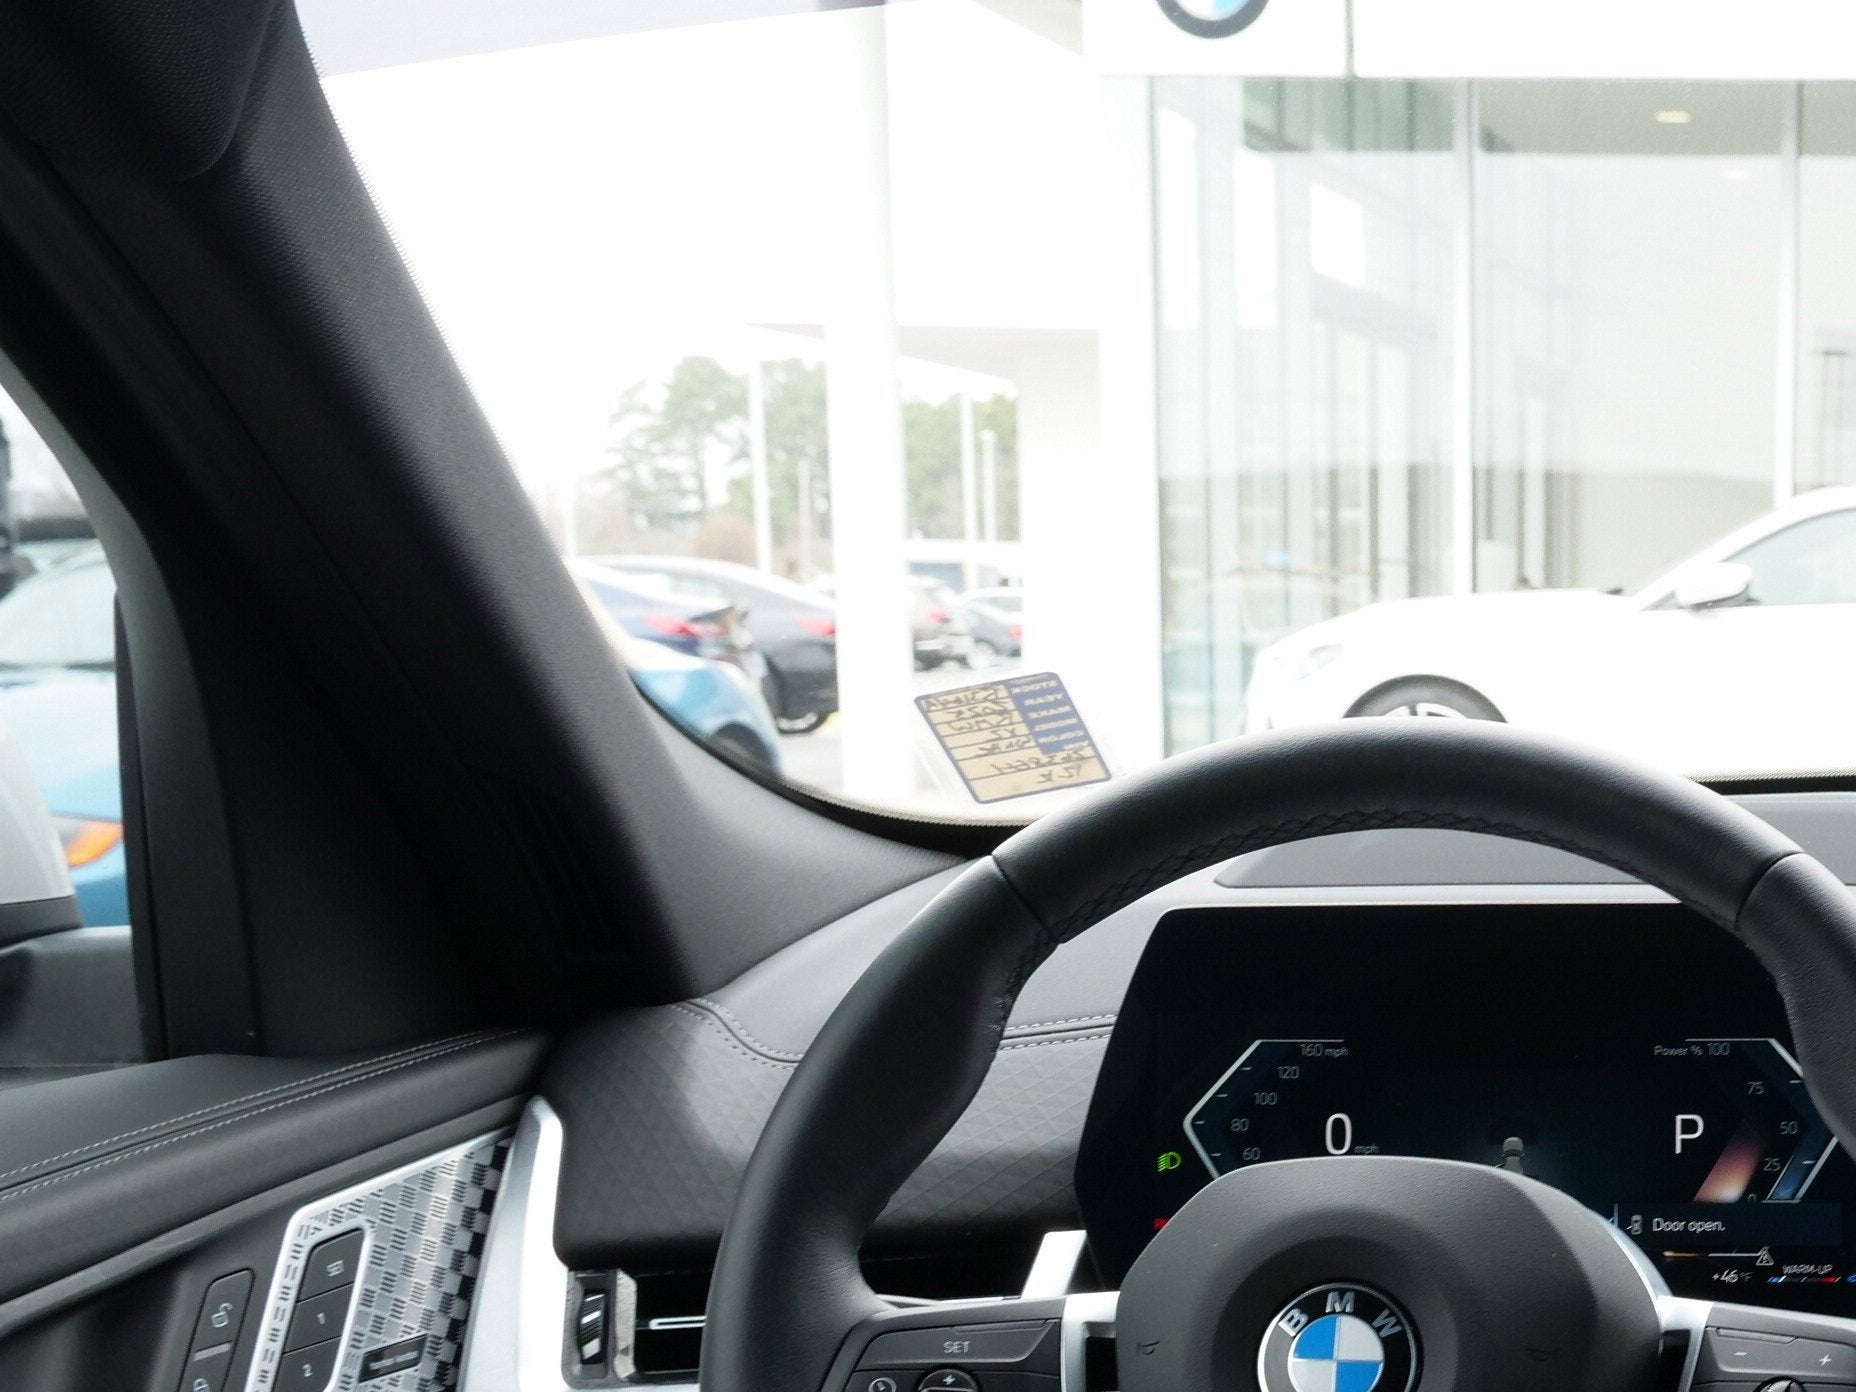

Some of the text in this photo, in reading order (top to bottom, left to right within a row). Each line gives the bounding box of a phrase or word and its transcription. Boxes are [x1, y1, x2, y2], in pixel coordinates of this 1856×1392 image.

[1300, 1043, 1348, 1057] 160 mph
[1654, 1042, 1730, 1056] Power % 100
[1277, 1066, 1299, 1078] 120
[1747, 1082, 1764, 1094] 75
[1254, 1092, 1277, 1105] 100
[1231, 1118, 1249, 1131] 80
[1780, 1121, 1797, 1134] 50
[1325, 1112, 1352, 1155] 0
[1676, 1115, 1703, 1154] P
[1243, 1148, 1260, 1160] 60
[1763, 1158, 1781, 1172] 25
[1652, 1218, 1725, 1233] Door open.
[1782, 1265, 1833, 1274] WARM-UP
[1277, 1291, 1403, 1338] BMW
[944, 1341, 971, 1353] SET
